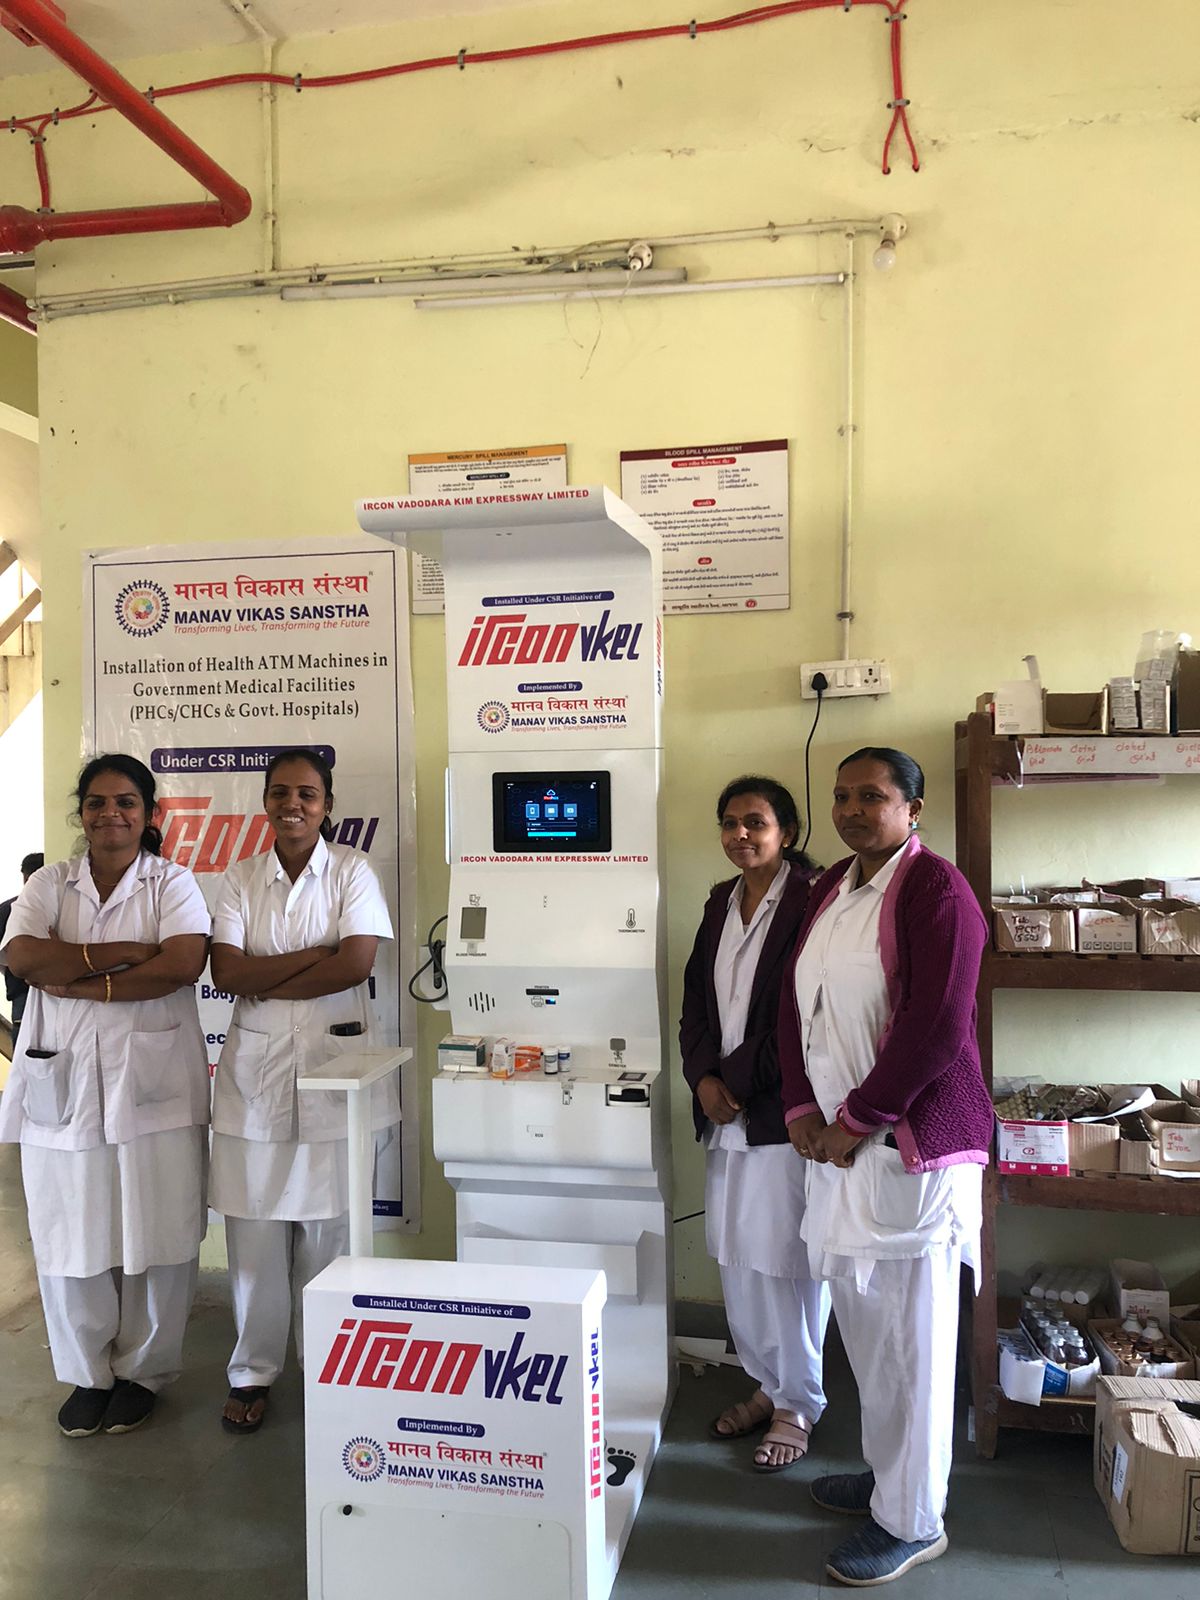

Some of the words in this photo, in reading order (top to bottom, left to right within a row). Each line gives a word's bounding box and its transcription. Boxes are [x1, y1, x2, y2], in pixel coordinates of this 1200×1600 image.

[490, 450, 529, 458] MANAGEMENT
[702, 446, 743, 454] MANAGEMENT
[363, 501, 395, 511] IRCON
[397, 498, 451, 509] VADODARA
[454, 496, 474, 506] KIM
[476, 492, 544, 505] EXPRESSWAY
[547, 489, 589, 500] LIMITED
[174, 581, 228, 600] मानव
[234, 574, 304, 599] विकास
[313, 573, 369, 595] संस्था
[563, 593, 593, 601] Initiative
[174, 609, 232, 625] MANAV
[236, 606, 285, 622] VIKAS
[290, 604, 370, 620] SANSTHA
[173, 624, 232, 635] Transforming
[234, 623, 258, 633] Lives,
[261, 621, 321, 632] Transforming
[323, 620, 338, 629] the
[340, 619, 370, 629] Future
[457, 614, 580, 666] ircon
[581, 609, 643, 662] vkel
[103, 659, 184, 675] Installation
[188, 657, 203, 672] of
[206, 656, 254, 672] Health
[257, 654, 295, 670] ATM
[298, 653, 370, 669] Machines
[373, 652, 388, 667] in
[133, 681, 222, 697] Government
[225, 679, 283, 695] Medical
[287, 677, 356, 693] Facilities
[523, 683, 567, 692] Implemented
[568, 682, 578, 691] By
[130, 703, 221, 723] (PHCs/CHCs
[224, 706, 236, 718] &
[238, 702, 279, 718] Govt.
[282, 700, 359, 721] Hospitals)
[511, 700, 543, 712] मानव
[547, 697, 588, 711] विकास
[593, 696, 626, 710] संस्था
[511, 717, 546, 727] MANAV
[549, 716, 577, 726] VIKAS
[580, 714, 627, 725] SANSTHA
[160, 754, 204, 768] Under
[208, 753, 236, 767] CSR
[369, 1298, 408, 1309] Installed
[410, 1301, 437, 1311] Under
[439, 1303, 459, 1312] CSR
[461, 1305, 502, 1315] Initiative
[503, 1307, 514, 1316] of
[318, 1318, 484, 1396] ircon
[484, 1331, 569, 1405] vkel
[405, 1419, 463, 1432] Implemented
[465, 1424, 478, 1436] By
[387, 1441, 431, 1459] मानव
[436, 1441, 492, 1466] विकास
[499, 1449, 544, 1470] संस्था
[388, 1464, 434, 1479] MANAV
[438, 1469, 477, 1483] VIKAS
[481, 1473, 544, 1490] SANSTHA
[387, 1476, 435, 1489] Transforming
[436, 1481, 454, 1490] Lives,
[457, 1484, 505, 1496] Transforming
[506, 1488, 519, 1496] the
[520, 1489, 545, 1499] Future
